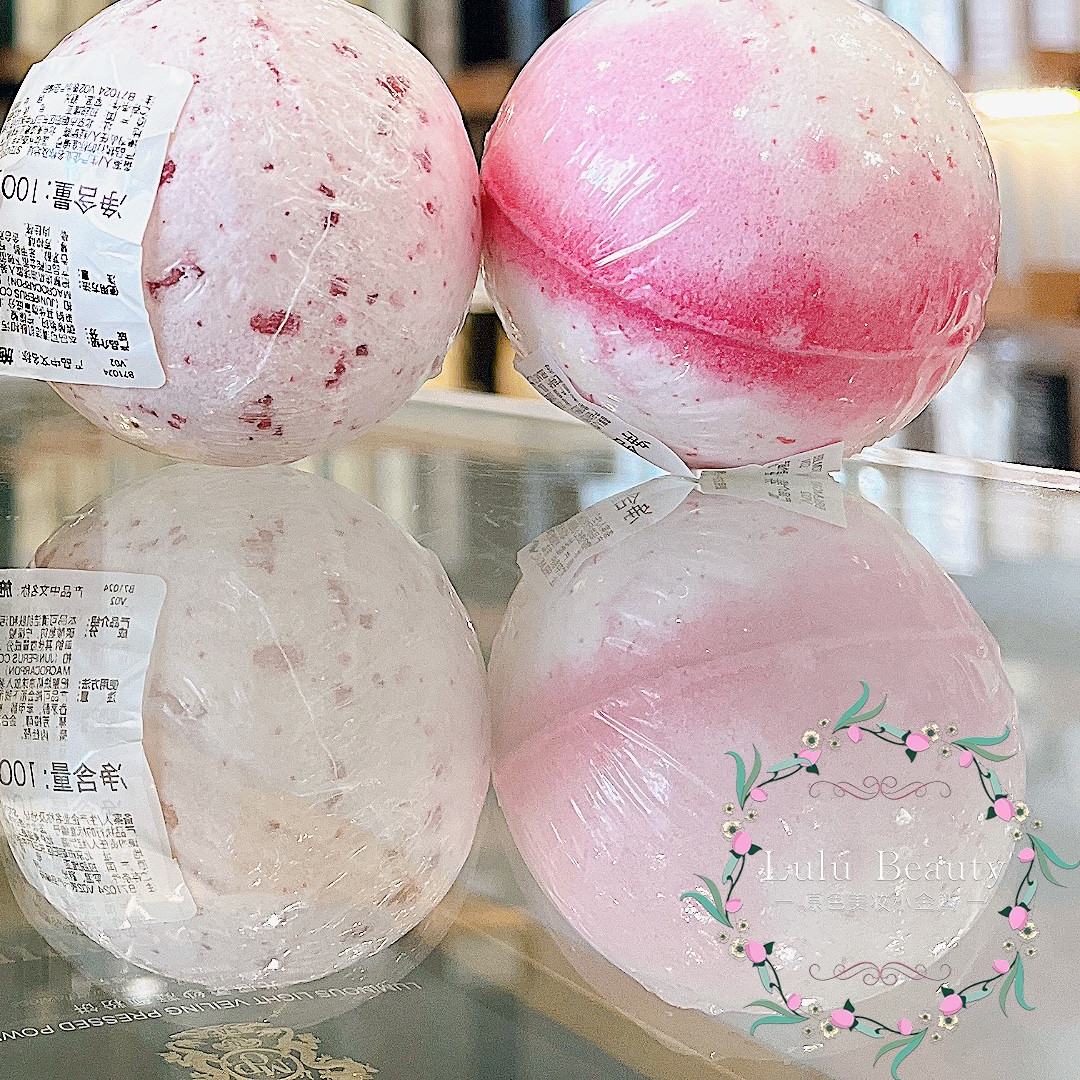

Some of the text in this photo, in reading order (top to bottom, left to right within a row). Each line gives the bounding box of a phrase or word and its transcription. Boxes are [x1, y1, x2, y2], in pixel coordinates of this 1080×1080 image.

[252, 990, 312, 1005] LIGHT
[163, 998, 250, 1017] VEILING
[58, 1009, 162, 1031] PRESSED
